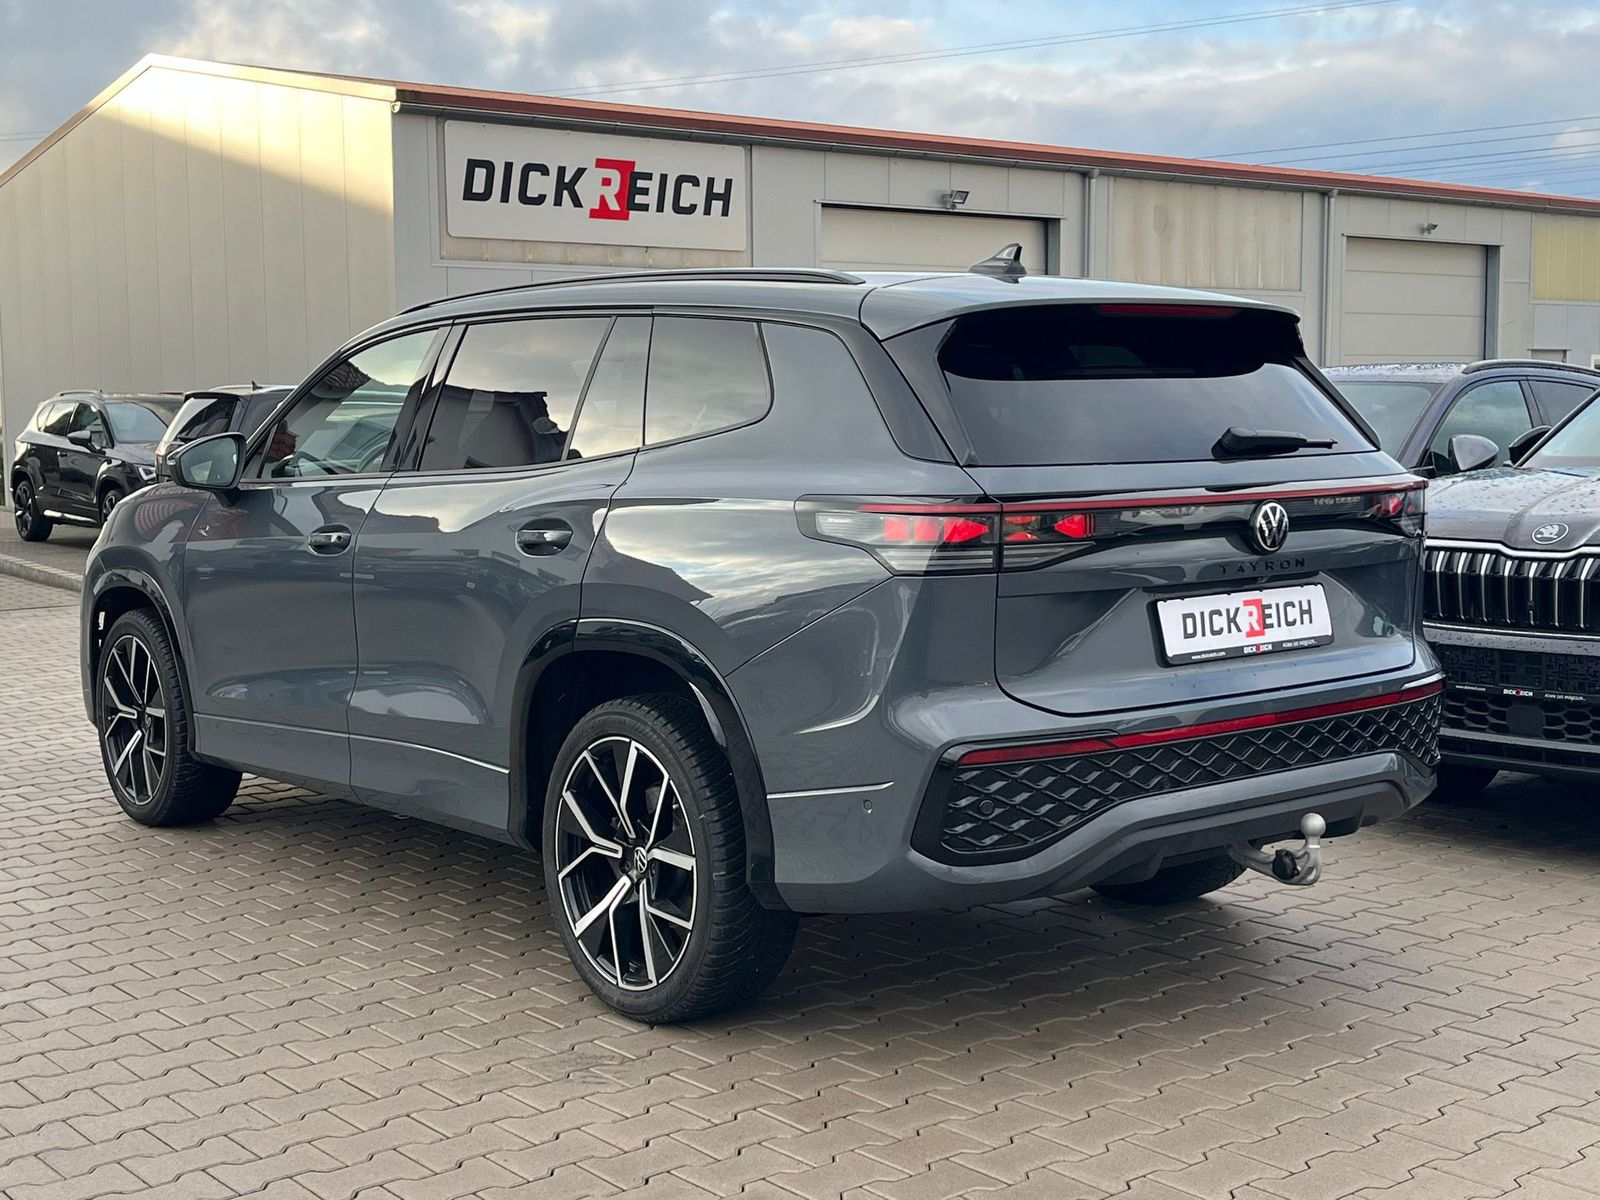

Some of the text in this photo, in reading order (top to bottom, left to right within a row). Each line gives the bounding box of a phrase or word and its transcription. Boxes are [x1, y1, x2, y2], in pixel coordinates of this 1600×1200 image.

[462, 158, 733, 221] DICKREICH
[1219, 558, 1305, 574] TAYRON
[1181, 598, 1313, 639] DICKREICH
[1503, 688, 1533, 697] DICKEICH
